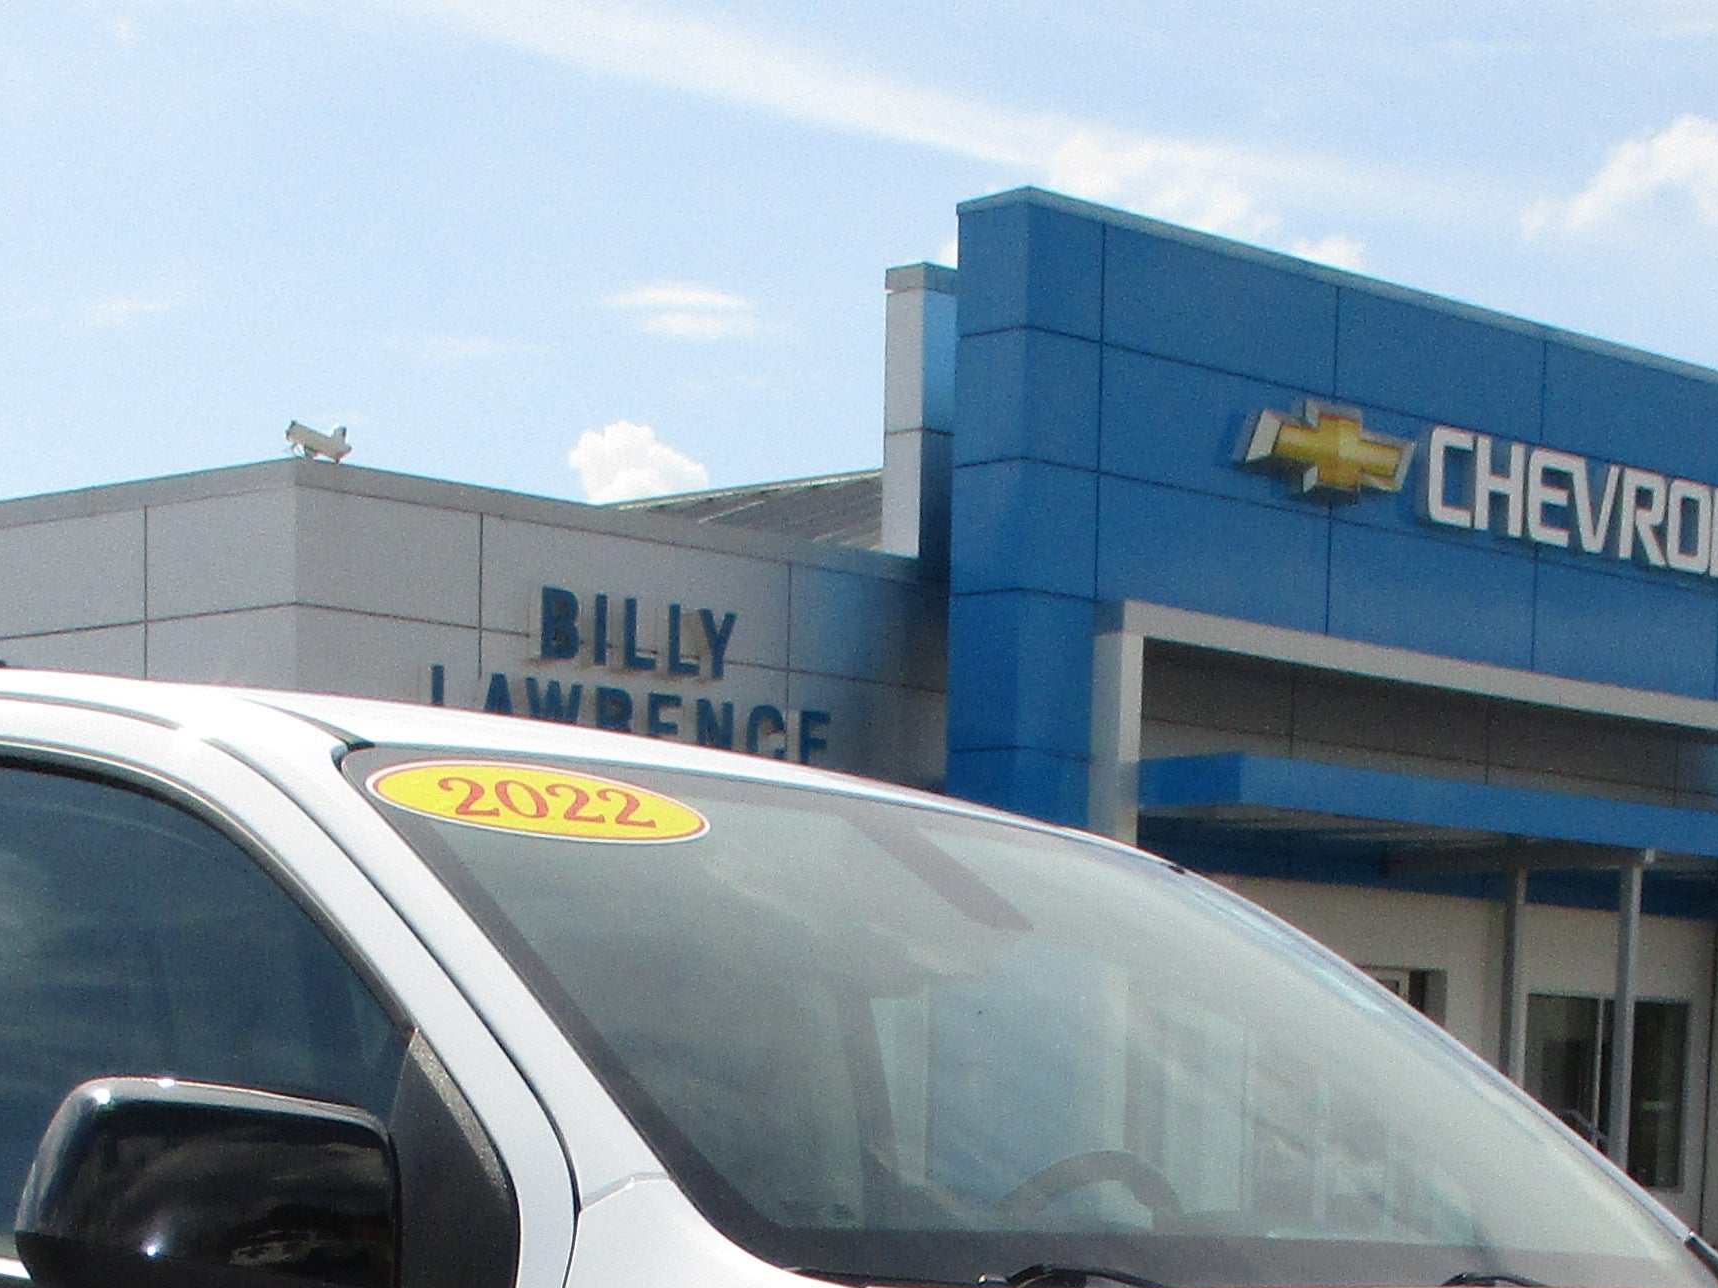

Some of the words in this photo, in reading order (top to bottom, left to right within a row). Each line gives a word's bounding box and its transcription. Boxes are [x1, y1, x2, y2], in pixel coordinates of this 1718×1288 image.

[539, 585, 738, 679] BILLY
[430, 663, 832, 765] LAWRENCE
[437, 774, 657, 830] 2022
